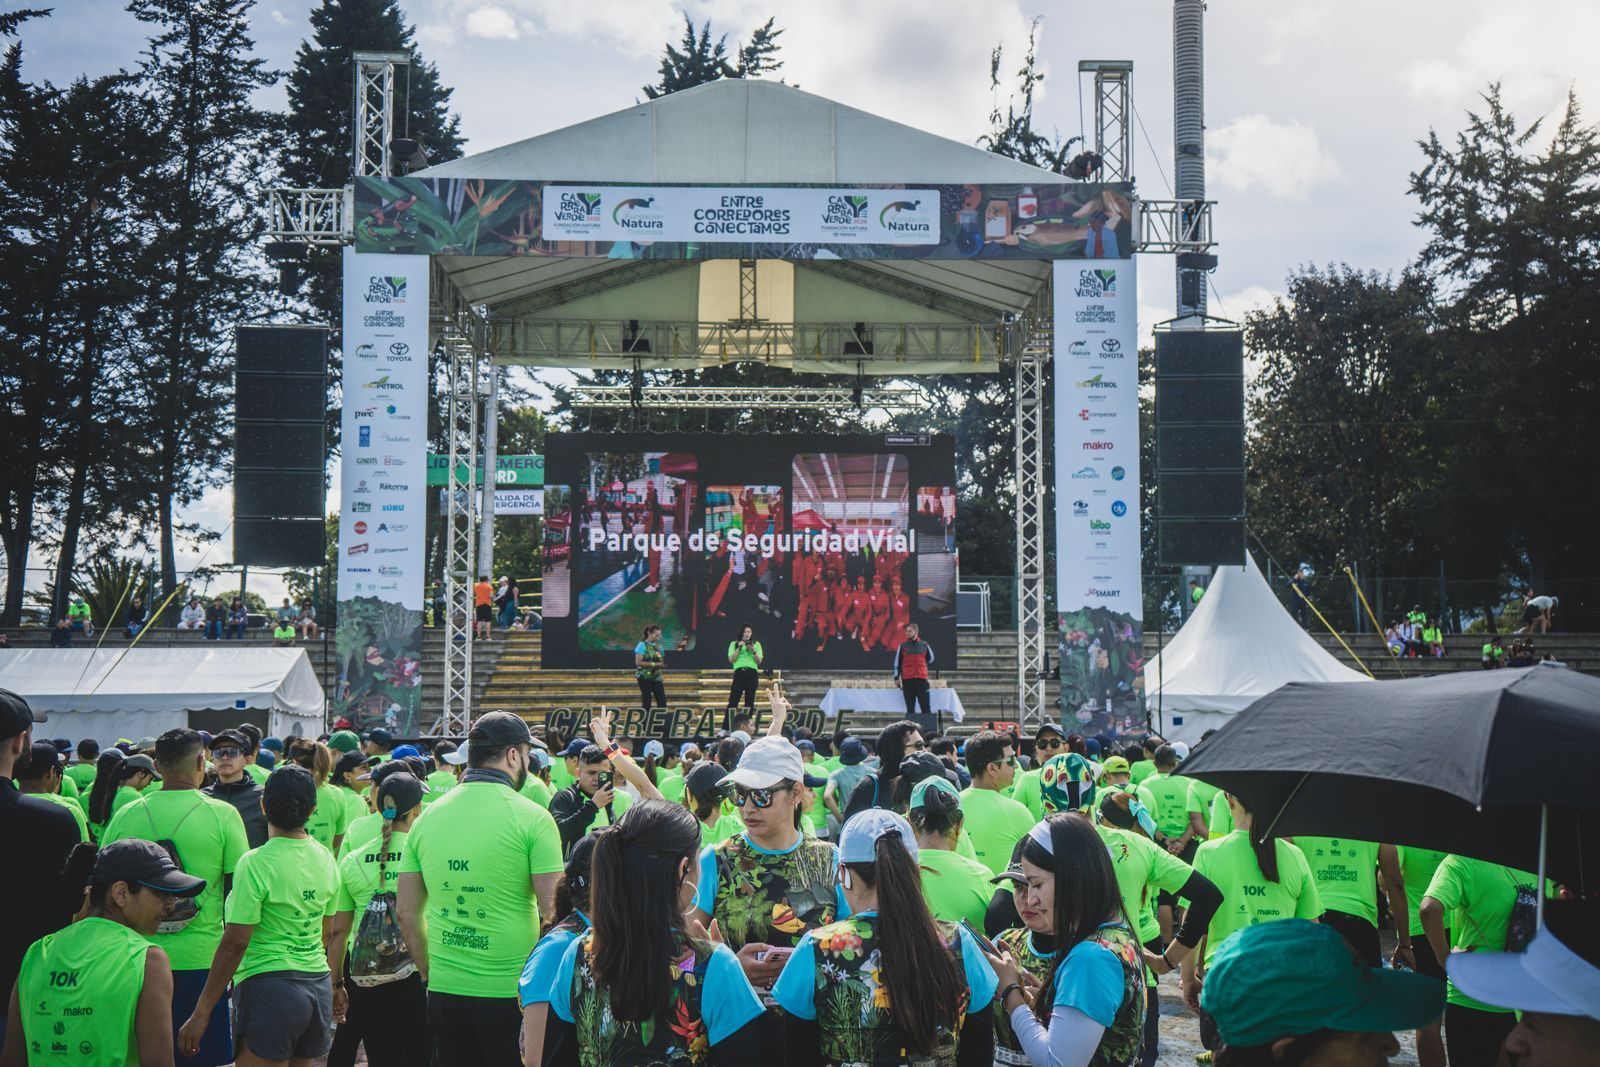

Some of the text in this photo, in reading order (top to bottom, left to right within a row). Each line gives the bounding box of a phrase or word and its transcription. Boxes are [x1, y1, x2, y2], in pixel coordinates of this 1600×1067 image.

[621, 218, 664, 229] Natura
[888, 221, 930, 231] Natura
[354, 411, 374, 419] pwc
[1082, 441, 1114, 450] makro
[379, 482, 409, 491] Retorna
[589, 528, 681, 558] Parque
[688, 528, 719, 552] de
[727, 527, 859, 558] Seguridad
[447, 859, 470, 871] 10K
[461, 885, 485, 893] makro
[1243, 885, 1267, 896] 10K
[302, 889, 316, 901] 5K
[49, 970, 80, 987] 10K
[63, 1006, 93, 1017] makro
